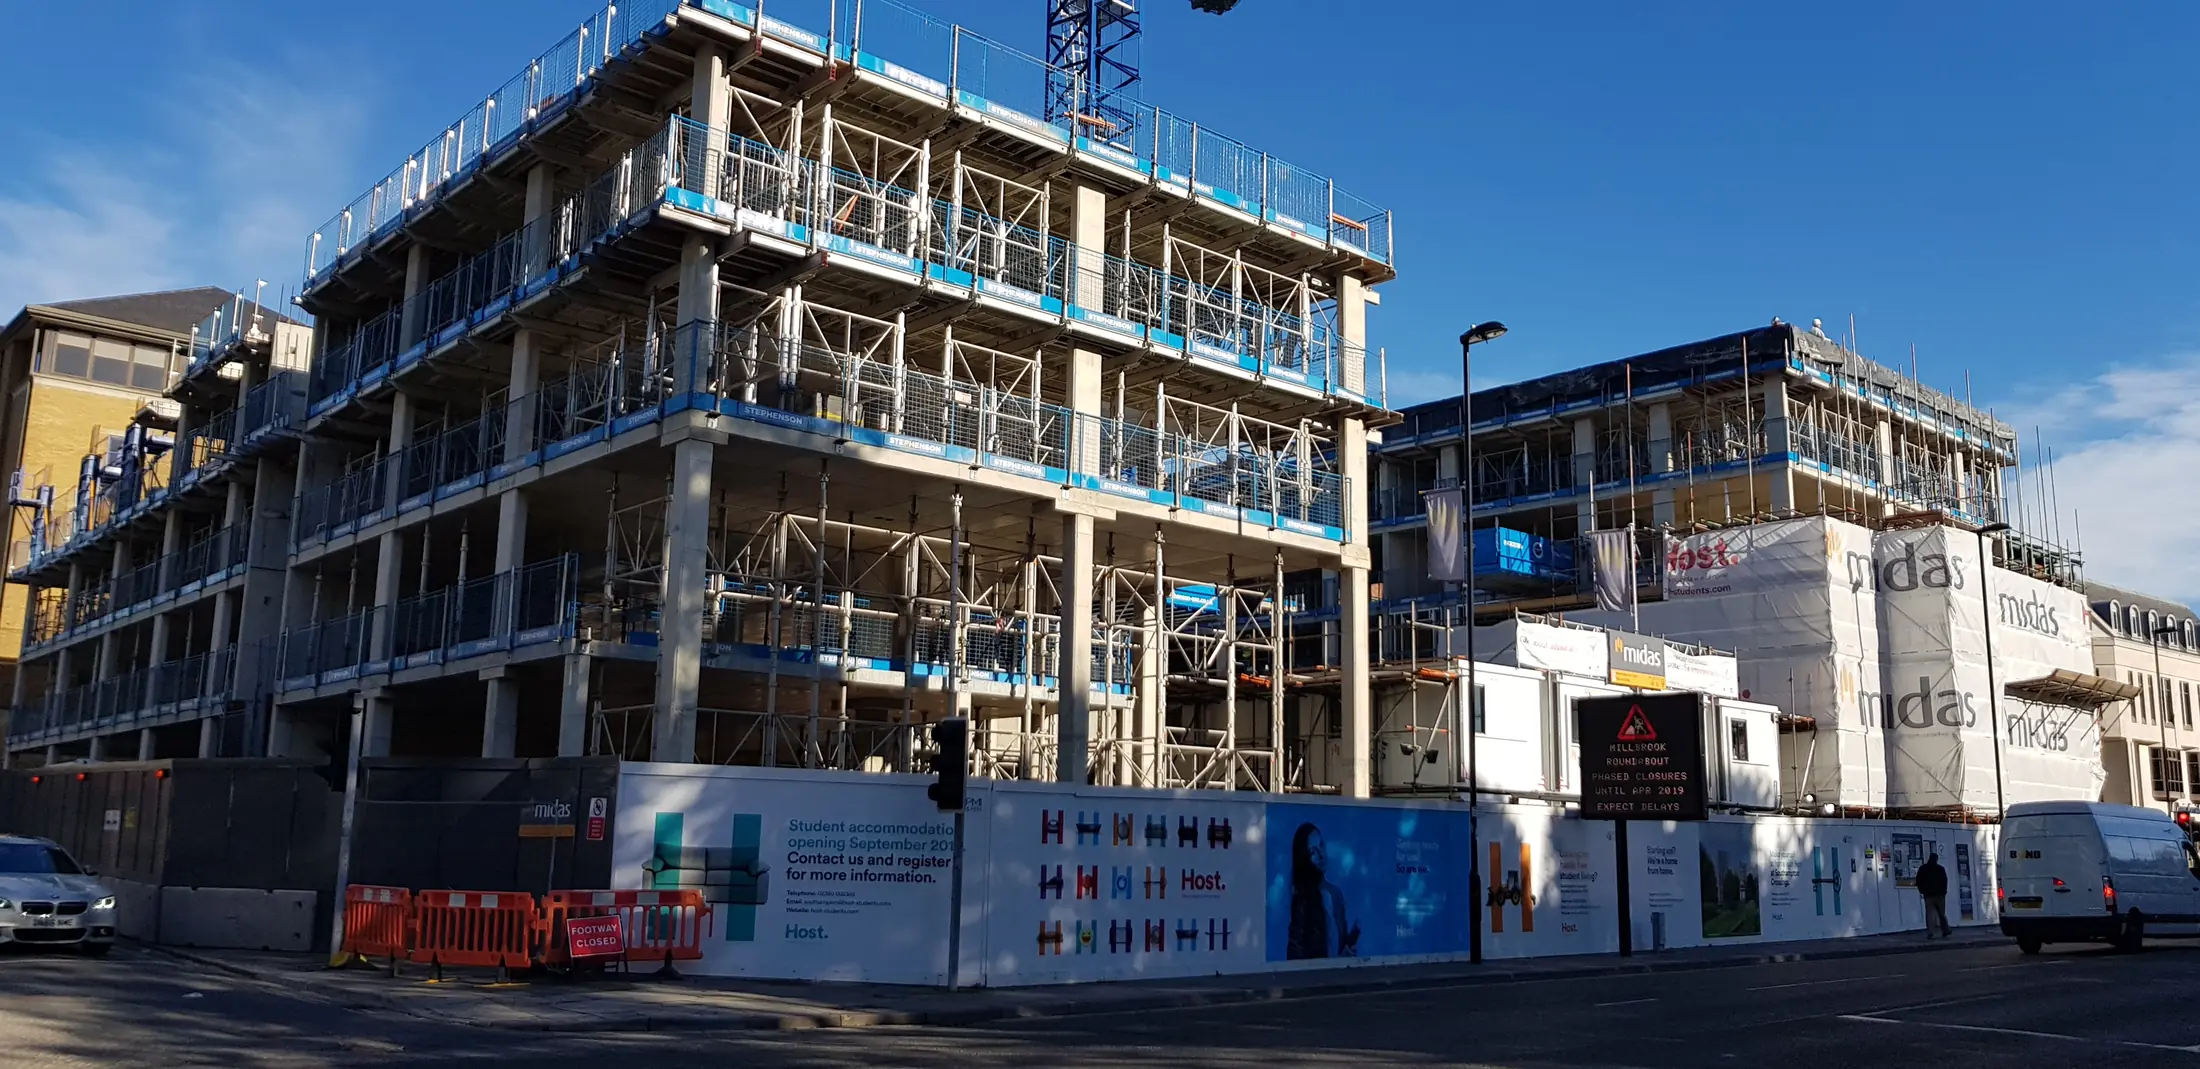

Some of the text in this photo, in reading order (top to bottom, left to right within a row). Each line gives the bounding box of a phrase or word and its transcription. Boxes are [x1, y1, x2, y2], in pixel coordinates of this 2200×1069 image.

[991, 105, 1038, 128] STEPHENSON
[1091, 143, 1135, 166] STEPHENSON
[855, 245, 910, 267] STEPHENSON
[1088, 313, 1132, 331] STEPHENSON
[744, 406, 803, 425] STEPHENSON
[889, 437, 942, 454] STEPHENSON
[994, 458, 1042, 475] STEPHENSON
[1103, 482, 1146, 497] STEPHENSON
[1847, 541, 1964, 593] midas
[1998, 589, 2059, 636] midas
[1624, 644, 1661, 666] midas
[1858, 676, 1976, 730] midas
[2008, 705, 2068, 752] midas
[1609, 742, 1667, 752] MILLBROOK
[1606, 756, 1670, 766] ROUNDABOUT
[1592, 772, 1687, 781] PHASED CLOSURES
[1595, 787, 1684, 795] UNTIL APR 2019
[534, 798, 571, 818] midas
[1597, 802, 1680, 811] EXPECT DELAYS
[789, 819, 954, 836] Student accommodatio
[788, 836, 845, 851] opening
[849, 836, 927, 852] September
[787, 851, 951, 870] Contact us and register
[786, 867, 936, 883] for more information.
[1182, 868, 1226, 891] Host.
[572, 924, 617, 935] FOOTWAY
[785, 923, 828, 939] Host.
[576, 936, 617, 948] CLOSED
